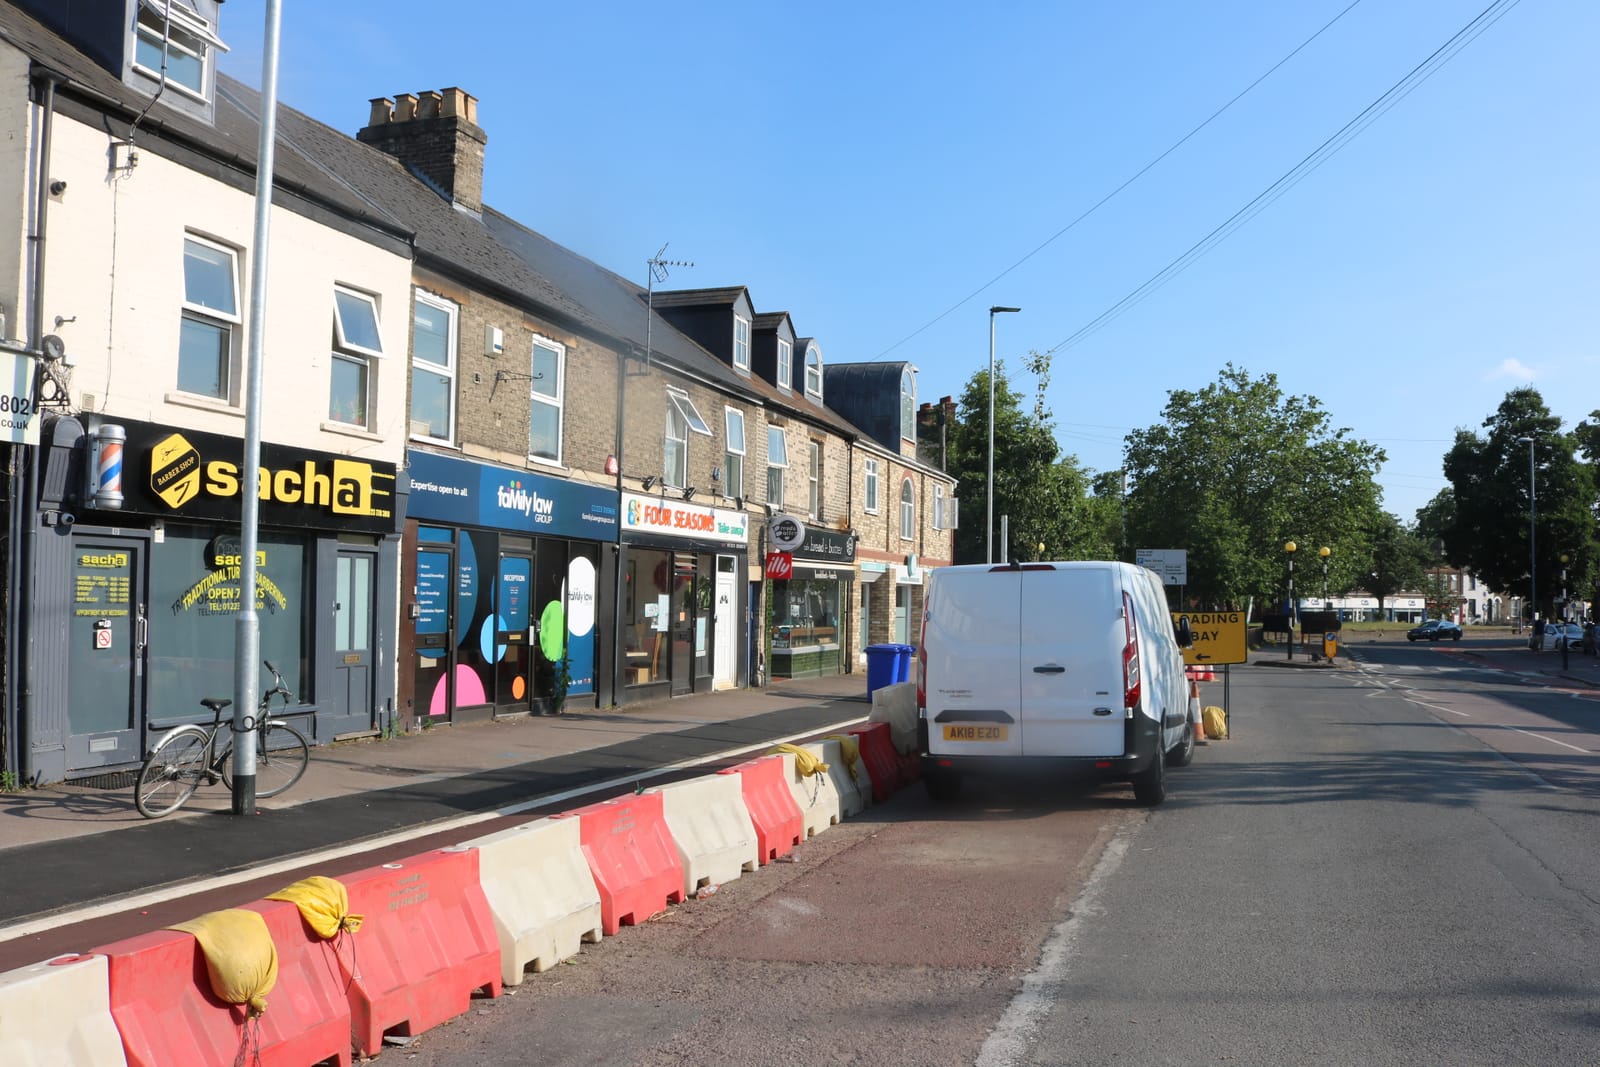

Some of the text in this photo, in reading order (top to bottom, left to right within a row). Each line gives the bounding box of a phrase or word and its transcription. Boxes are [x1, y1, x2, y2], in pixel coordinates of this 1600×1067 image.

[157, 456, 194, 485] BARBER SHOP
[410, 479, 468, 497] Expertise open to all
[533, 491, 553, 514] law
[534, 513, 553, 524] GROUP
[644, 505, 715, 532] FOUR SEASONS
[810, 535, 824, 552] bread
[81, 553, 127, 566] sacha
[215, 550, 266, 567] saca
[767, 555, 790, 577] illy
[182, 570, 227, 611] TRADITIONAL
[208, 588, 234, 599] OPEN
[208, 602, 222, 611] TEL:
[1191, 631, 1219, 642] BAY
[949, 726, 975, 739] AK18
